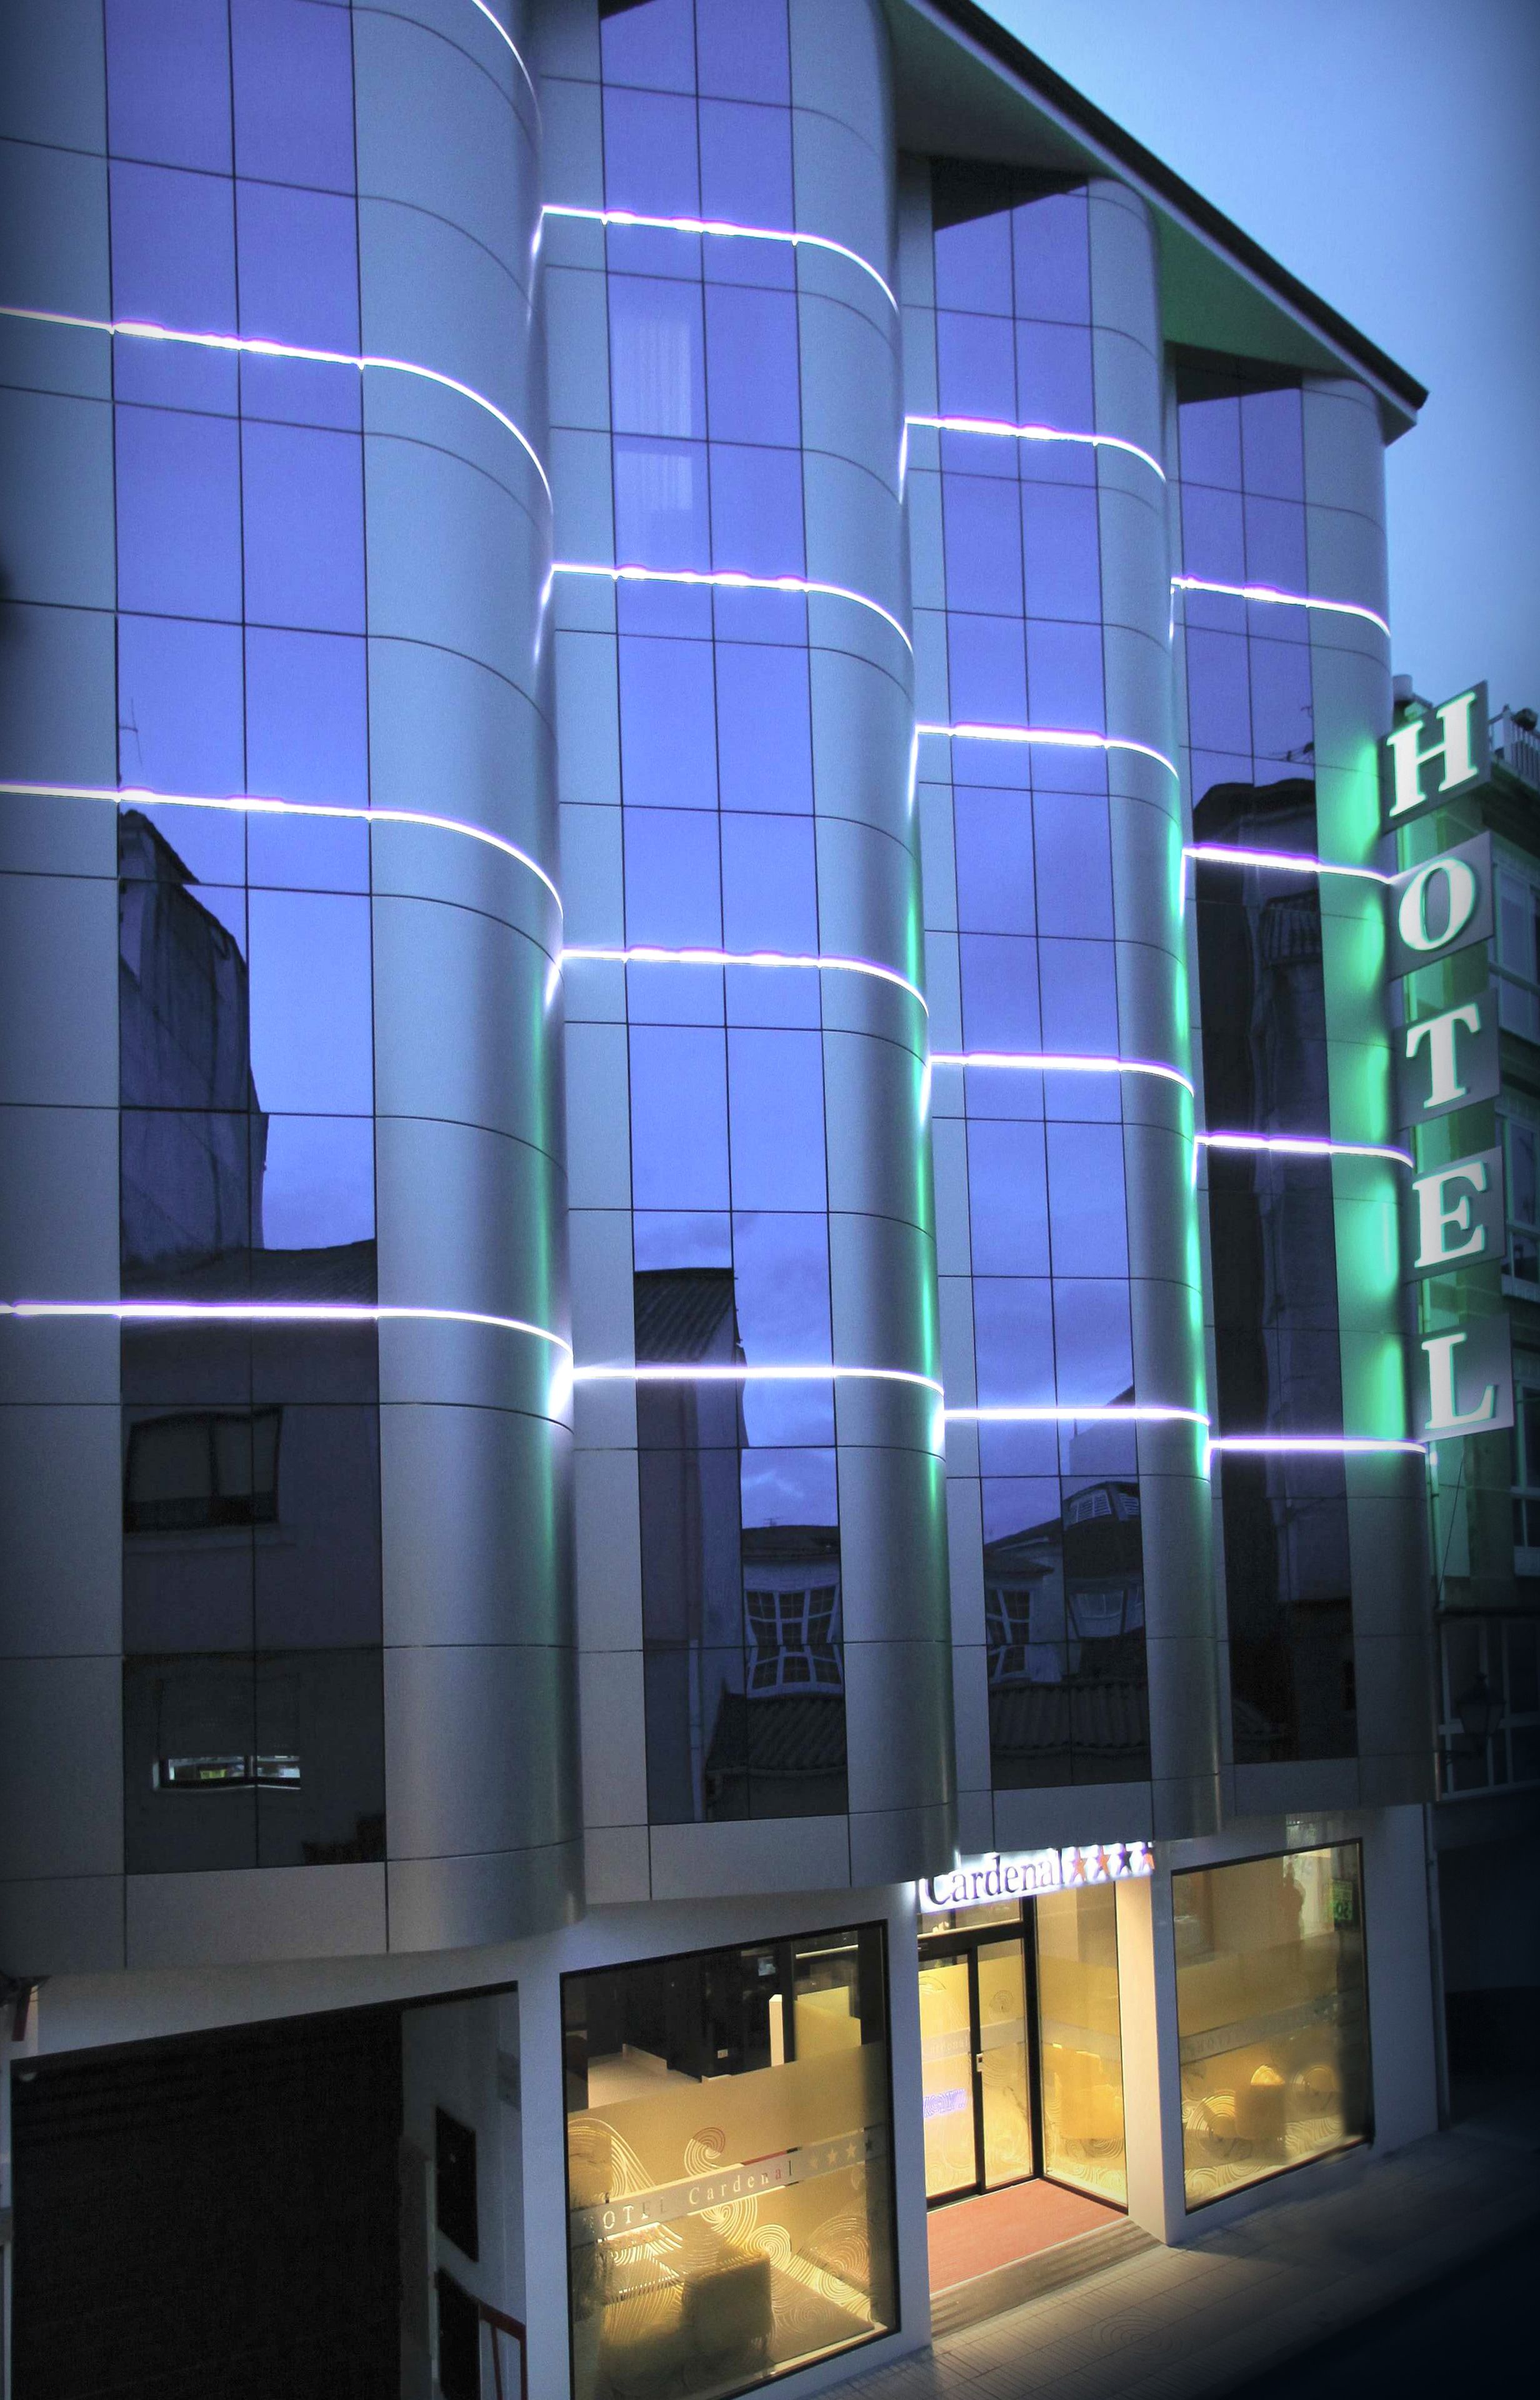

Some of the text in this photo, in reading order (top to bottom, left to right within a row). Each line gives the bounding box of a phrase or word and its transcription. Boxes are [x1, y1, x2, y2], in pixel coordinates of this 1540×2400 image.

[1386, 691, 1495, 1430] HOTEL
[925, 1848, 1064, 1905] Cardenal
[688, 2159, 793, 2206] Cardenal
